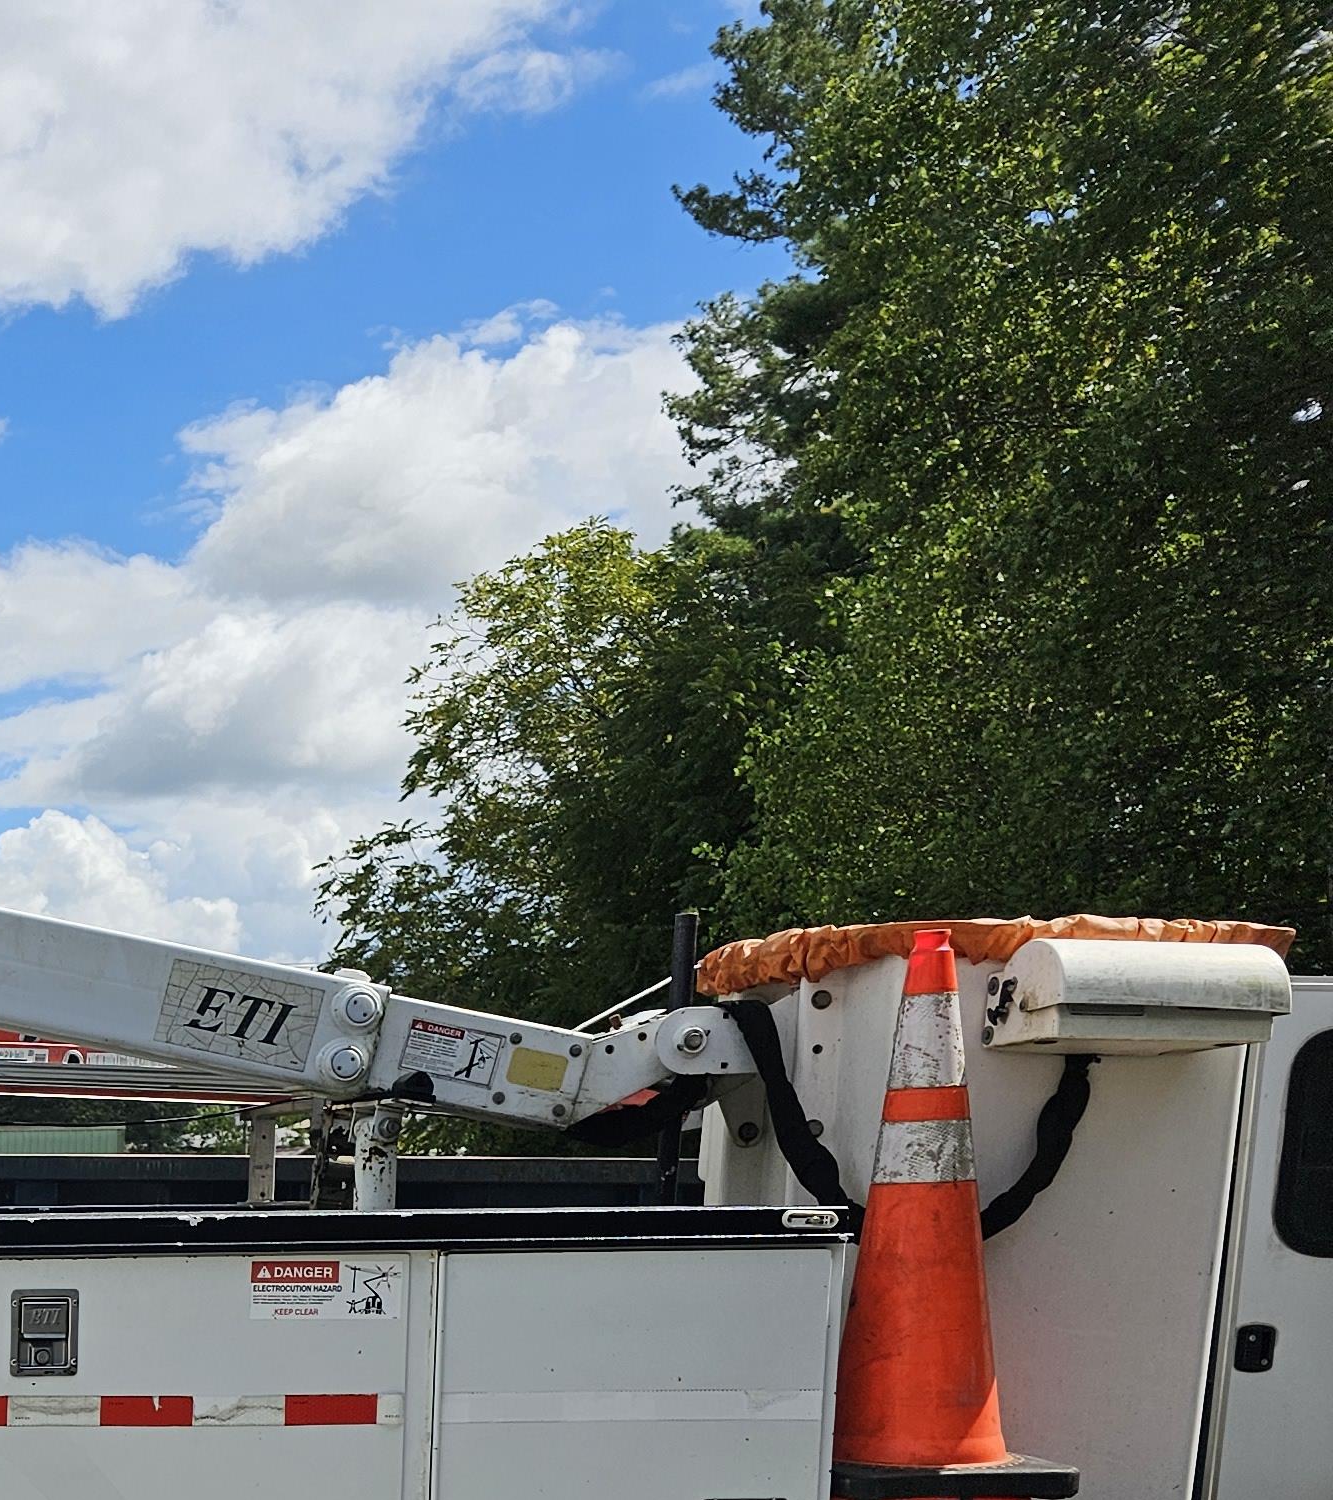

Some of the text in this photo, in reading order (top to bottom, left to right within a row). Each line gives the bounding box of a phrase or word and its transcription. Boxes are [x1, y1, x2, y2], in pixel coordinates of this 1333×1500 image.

[183, 986, 298, 1046] ETI
[427, 1024, 462, 1038] DANGER
[274, 1266, 333, 1279] DANGER
